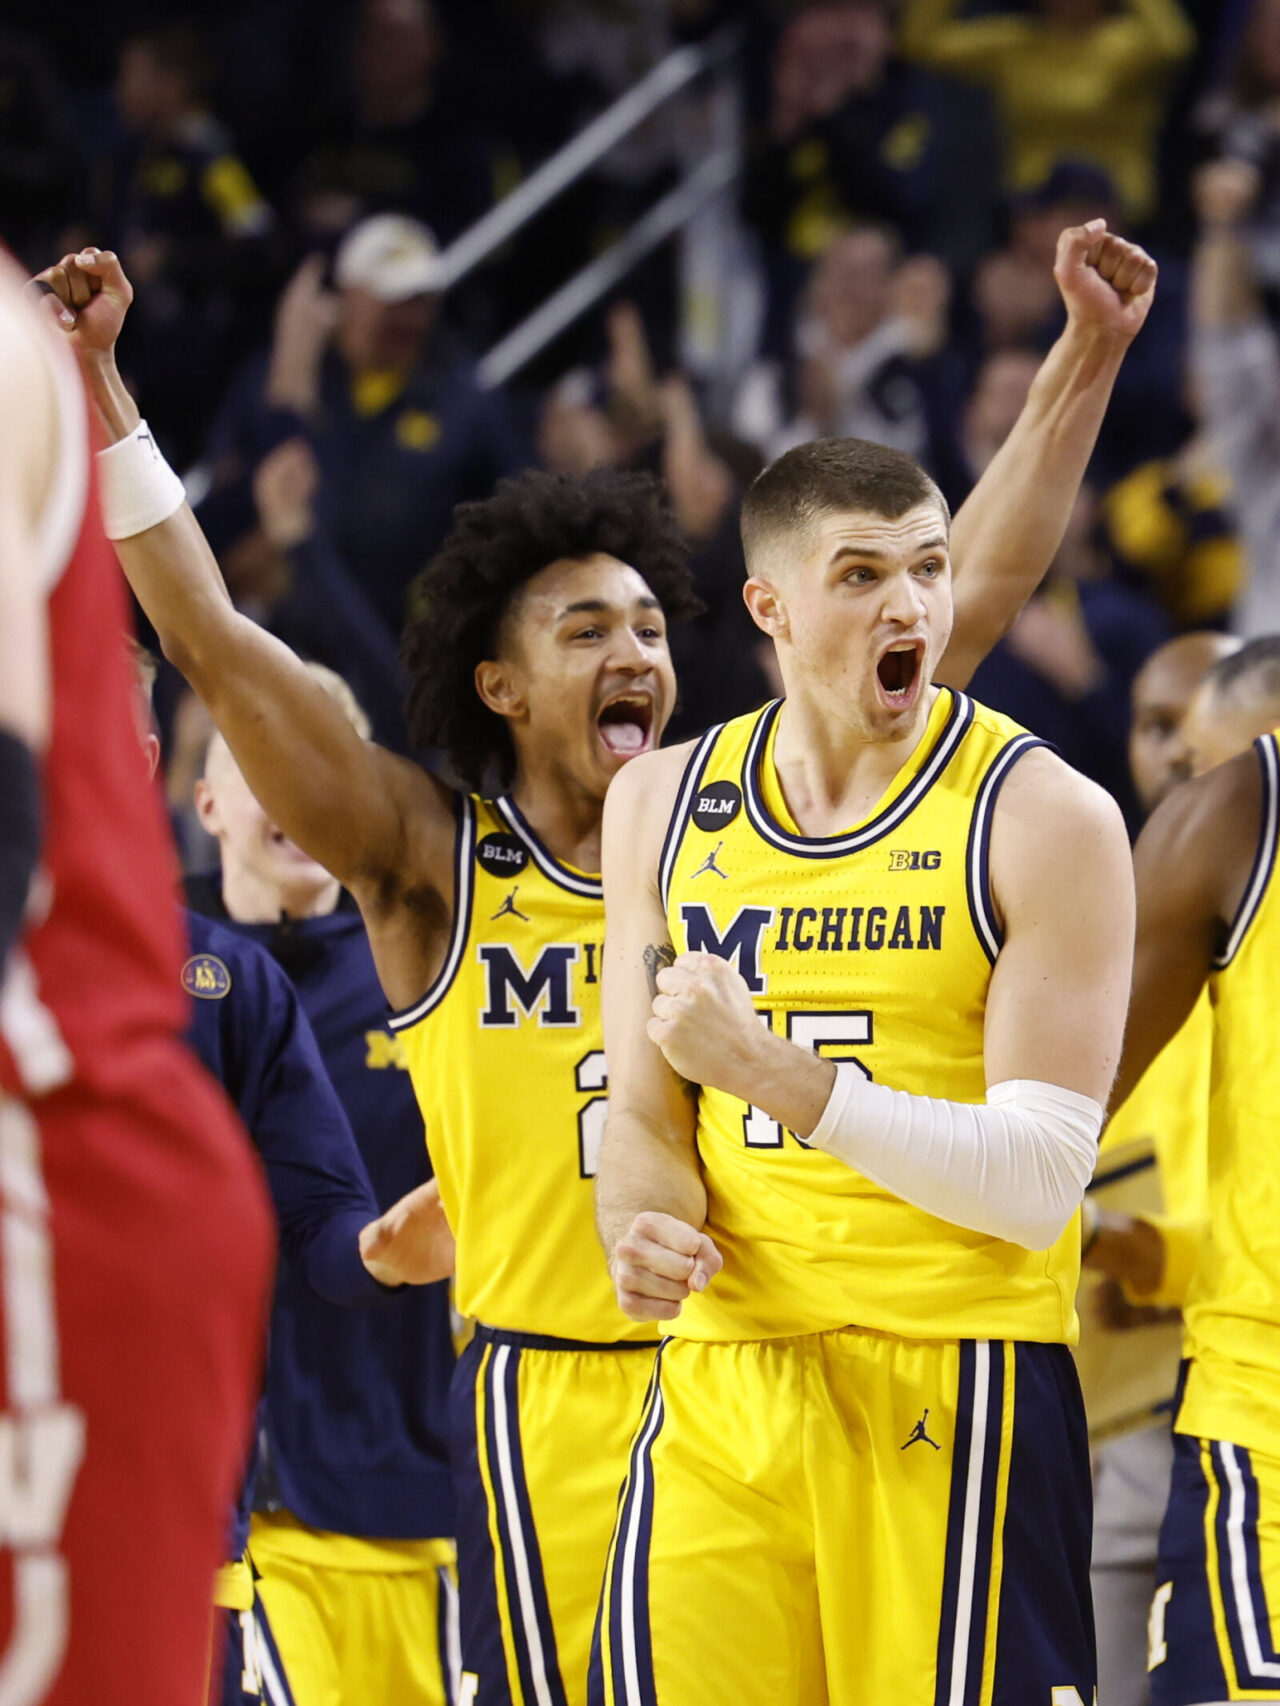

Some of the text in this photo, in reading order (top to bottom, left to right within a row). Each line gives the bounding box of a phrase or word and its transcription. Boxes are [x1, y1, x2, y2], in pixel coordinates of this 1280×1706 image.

[697, 797, 735, 815] BLM
[482, 843, 523, 864] BLM
[679, 902, 946, 995] MICHIGAN
